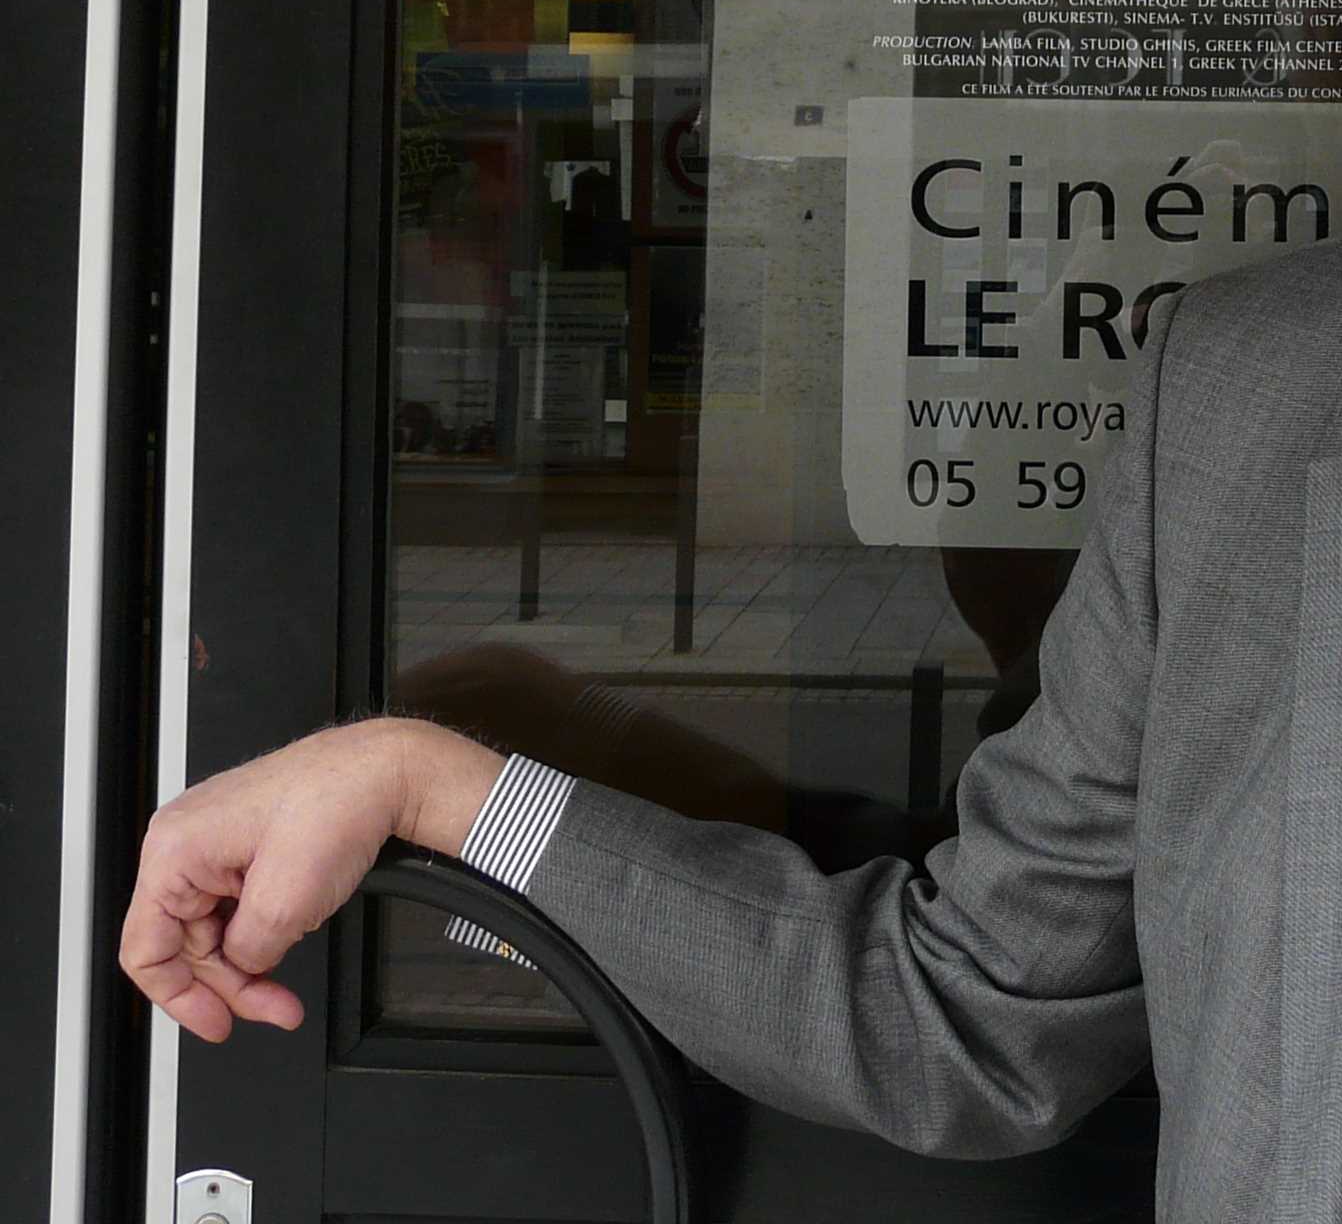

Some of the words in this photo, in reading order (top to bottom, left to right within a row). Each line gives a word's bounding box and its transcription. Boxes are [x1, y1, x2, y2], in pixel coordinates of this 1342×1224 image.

[1022, 11, 1119, 26] (BUKURESTI),
[982, 37, 1032, 50] LAMBA
[1036, 38, 1076, 52] FILM,
[1079, 38, 1139, 51] STUDIO
[1142, 39, 1201, 54] GHINIS,
[1205, 40, 1252, 53] GREEK
[1257, 40, 1291, 53] FILM
[902, 54, 986, 67] BULGARIAN
[991, 55, 1067, 68] NATIONAL
[1072, 56, 1091, 68] TV
[1095, 56, 1166, 69] CHANNEL
[1188, 57, 1235, 70] GREEK
[1240, 58, 1259, 71] TV
[1263, 58, 1335, 72] CHANNEL
[961, 83, 978, 95] CE
[981, 84, 1012, 95] FILM
[1014, 85, 1024, 95] A
[1027, 81, 1049, 96] ÉTÉ
[1052, 84, 1114, 96] SOUTENU
[1118, 85, 1142, 97] PAR
[1145, 86, 1159, 97] LE
[1162, 86, 1208, 97] FONDS
[1211, 87, 1284, 99] EURIMAGES
[1288, 88, 1308, 99] DU
[907, 279, 1020, 359] LE
[907, 396, 1126, 442] www.roya
[906, 458, 976, 510] 05
[1016, 459, 1088, 511] 59
